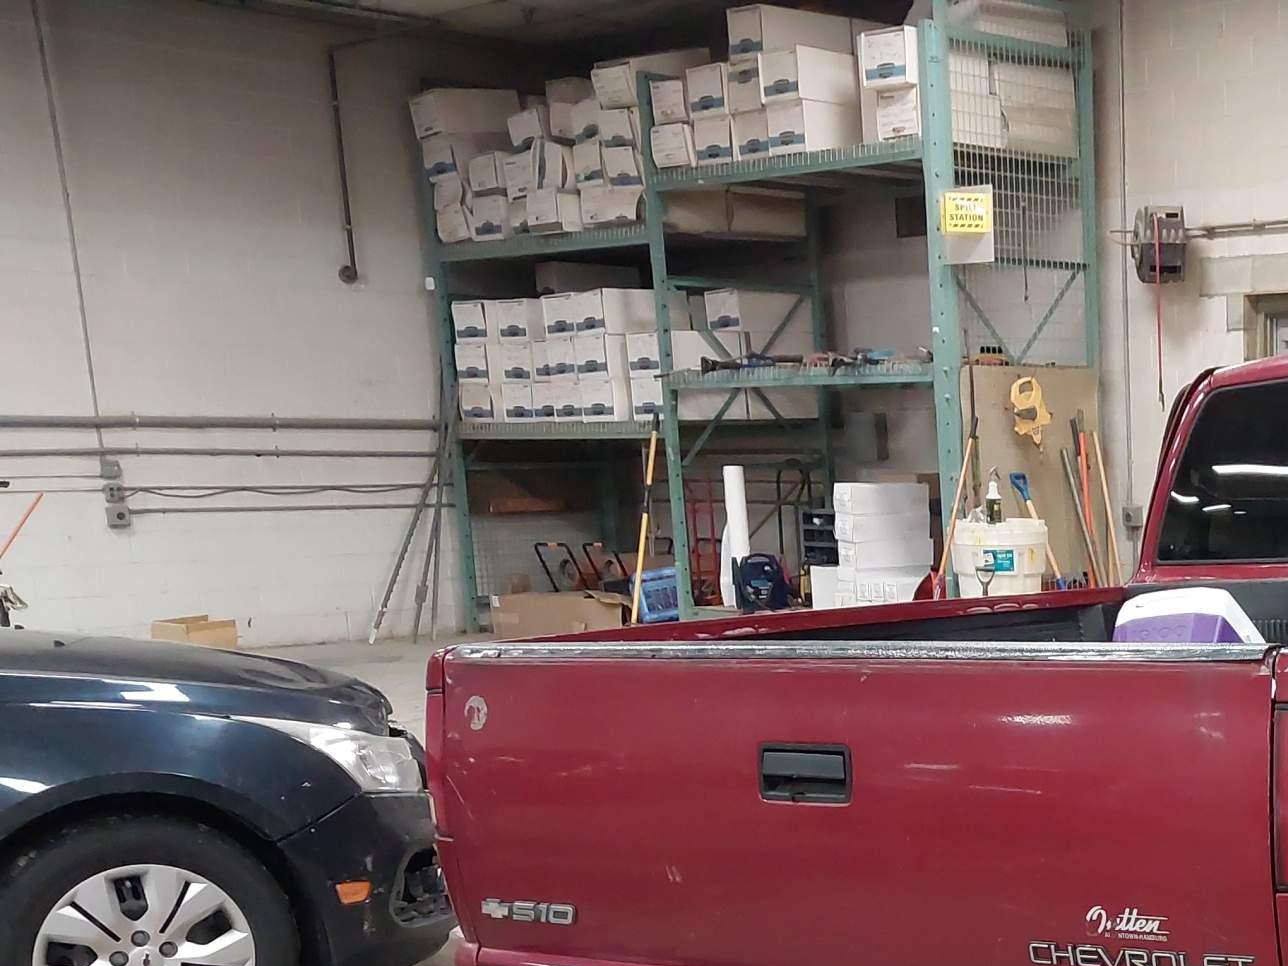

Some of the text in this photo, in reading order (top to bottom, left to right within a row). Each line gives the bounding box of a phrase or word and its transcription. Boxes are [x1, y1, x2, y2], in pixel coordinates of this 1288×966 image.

[955, 203, 978, 212] SPILL
[949, 213, 984, 222] STATION
[512, 901, 576, 925] S10
